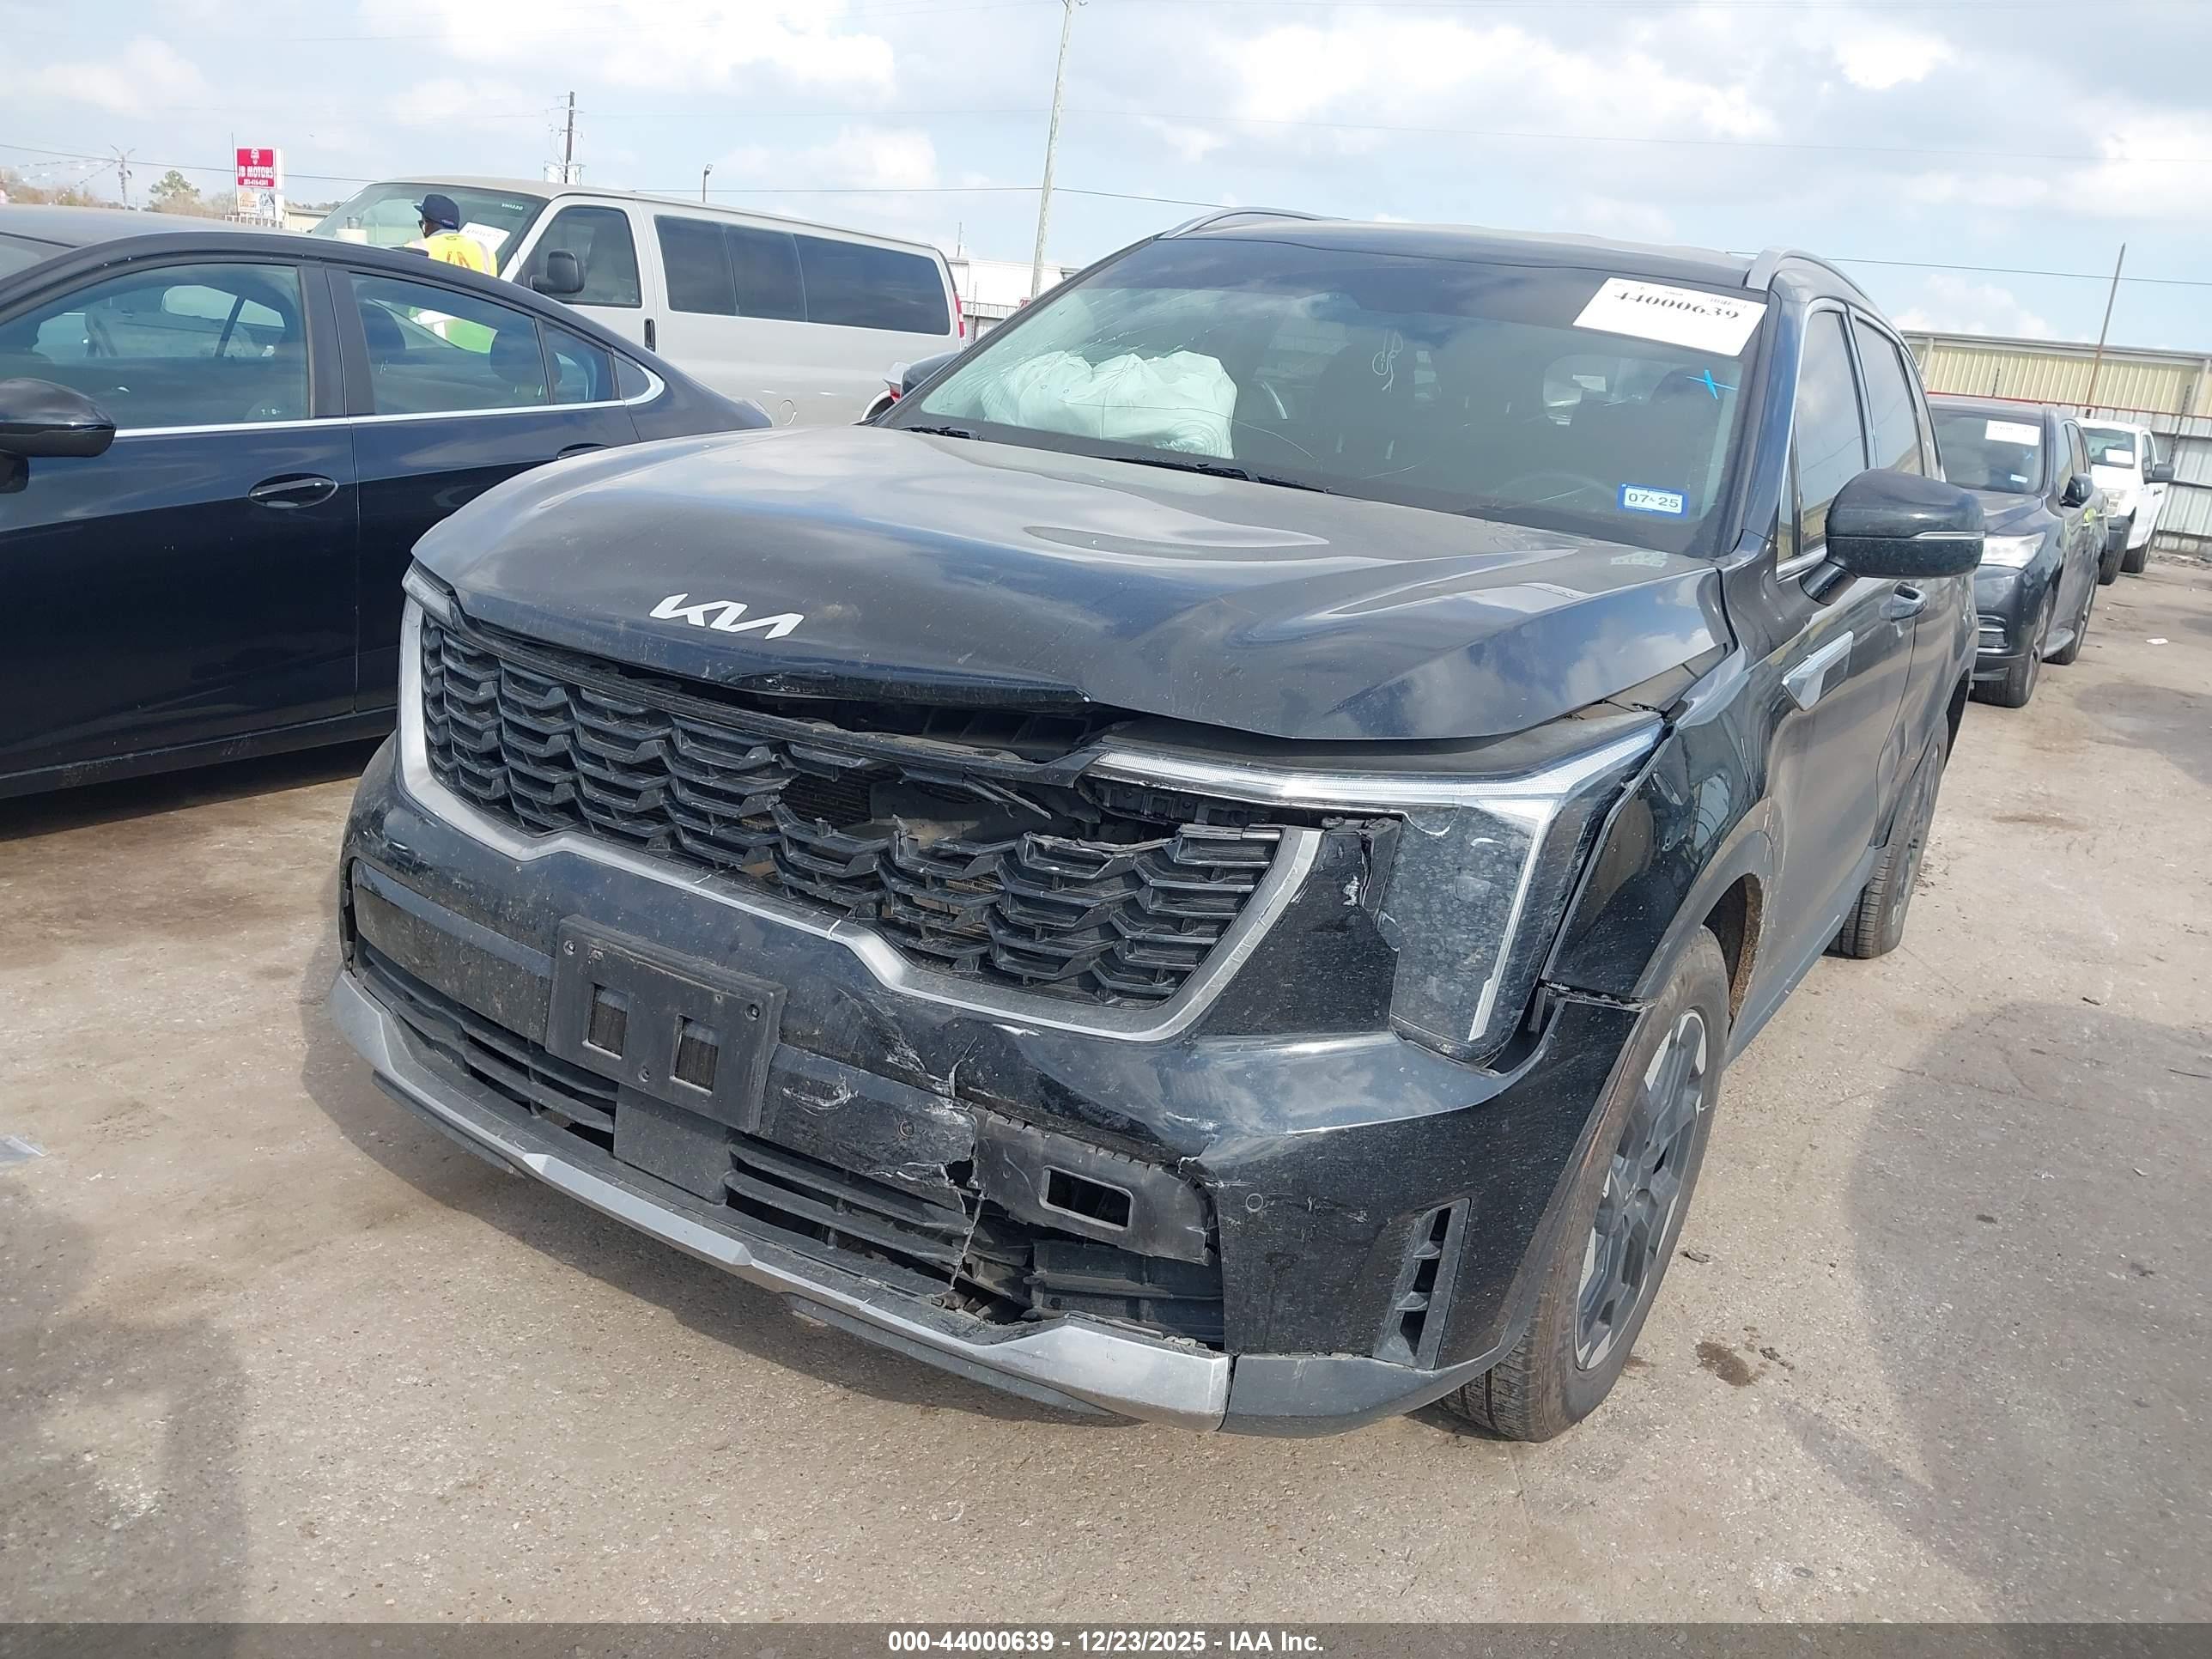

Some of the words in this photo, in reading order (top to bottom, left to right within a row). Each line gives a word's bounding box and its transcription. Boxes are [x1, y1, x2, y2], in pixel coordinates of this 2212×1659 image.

[247, 166, 274, 179] MOTORS
[1613, 291, 1740, 319] 44000639
[649, 592, 805, 640] KIA
